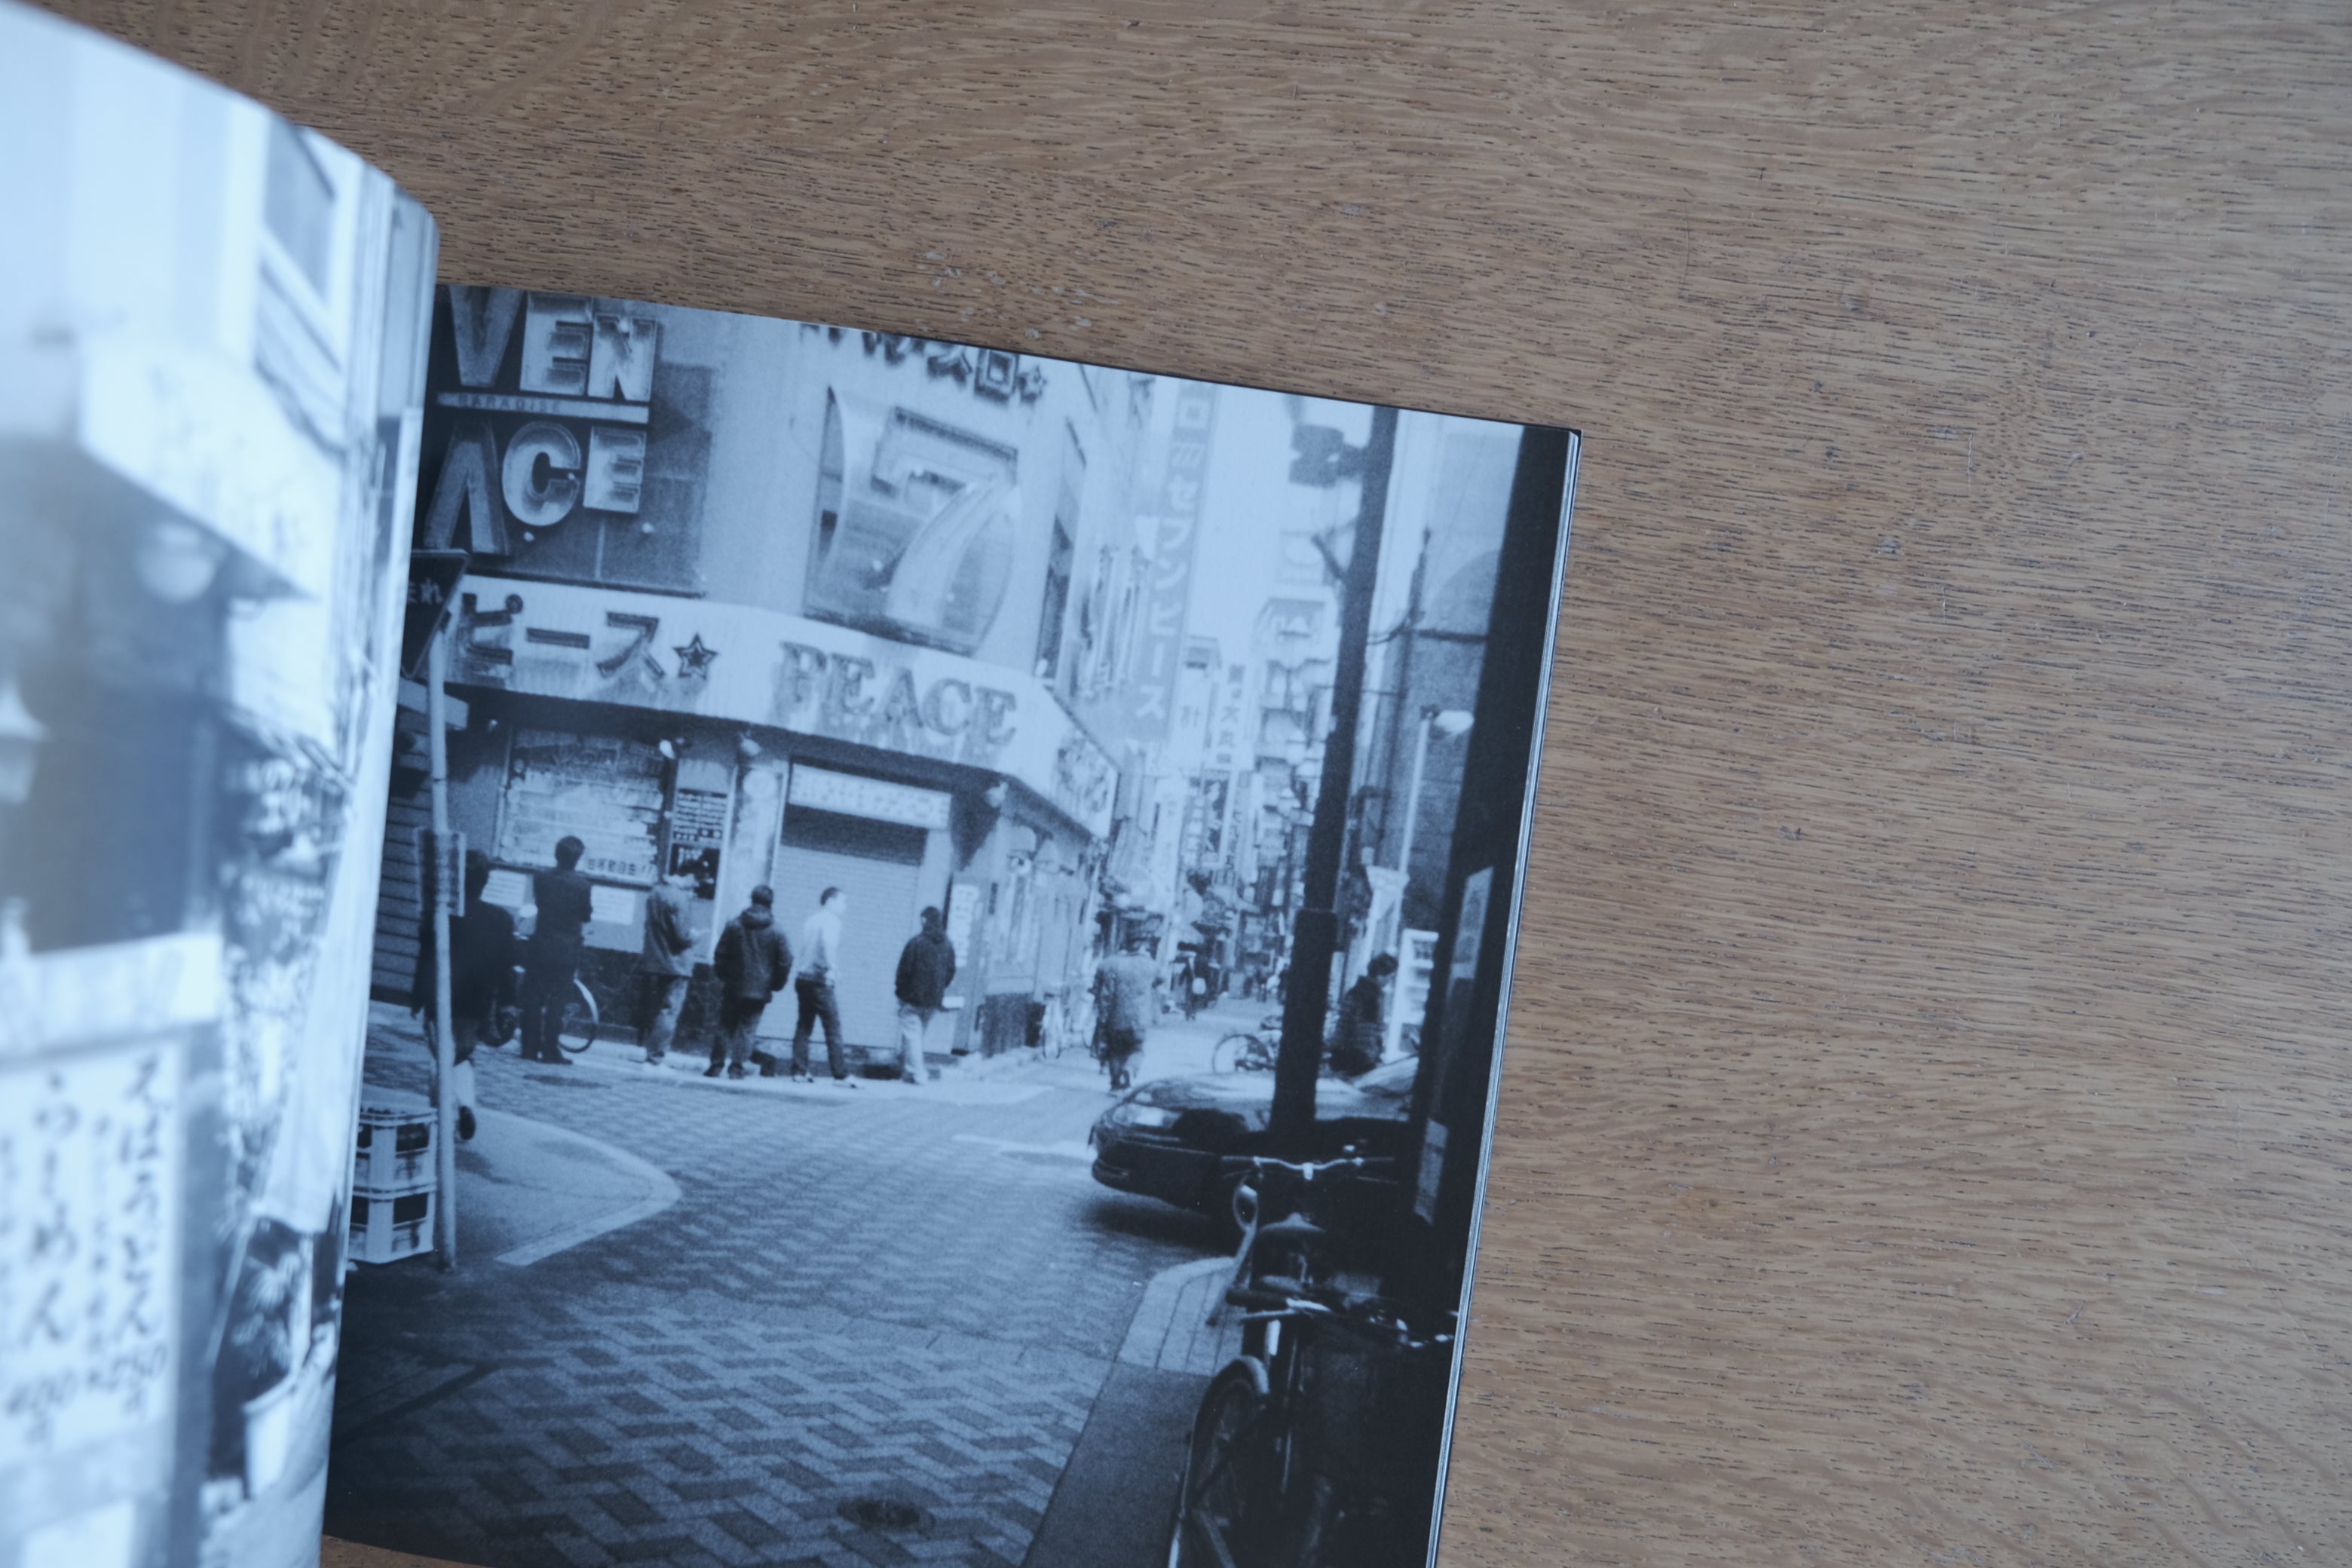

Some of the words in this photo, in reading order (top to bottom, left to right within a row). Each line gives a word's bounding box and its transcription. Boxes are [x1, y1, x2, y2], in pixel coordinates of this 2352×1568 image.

[458, 592, 665, 678] ピース
[777, 639, 1018, 748] PEACE
